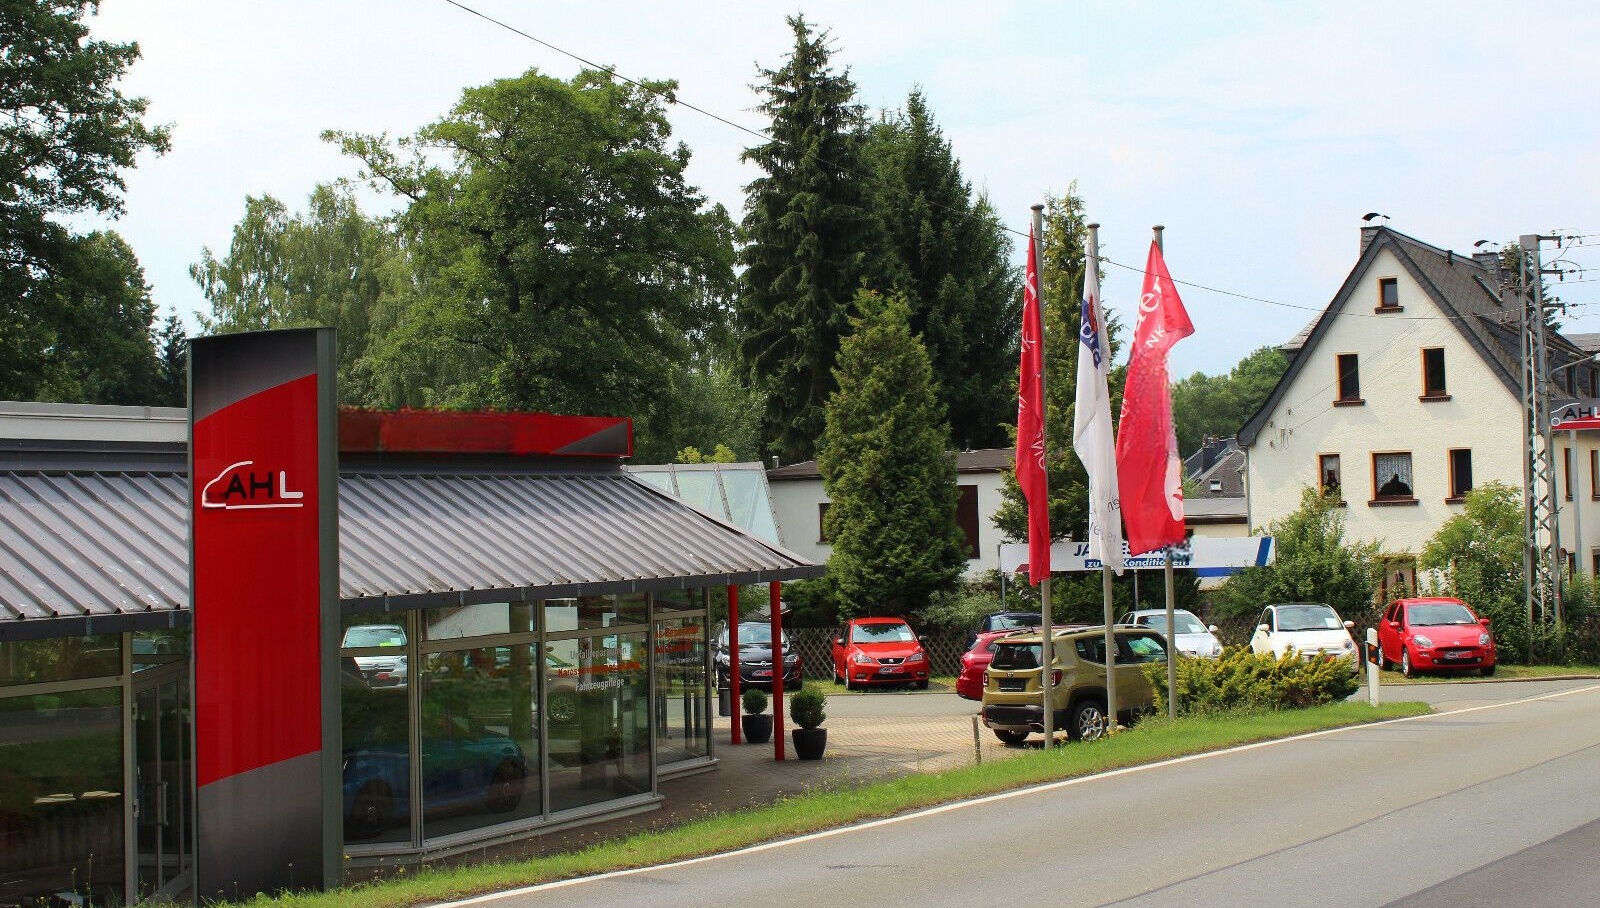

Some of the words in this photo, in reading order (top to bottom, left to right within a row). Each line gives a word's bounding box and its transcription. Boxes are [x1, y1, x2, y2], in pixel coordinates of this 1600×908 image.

[1563, 406, 1600, 419] AHL
[225, 470, 304, 499] AHL
[1123, 557, 1186, 567] Konditioen
